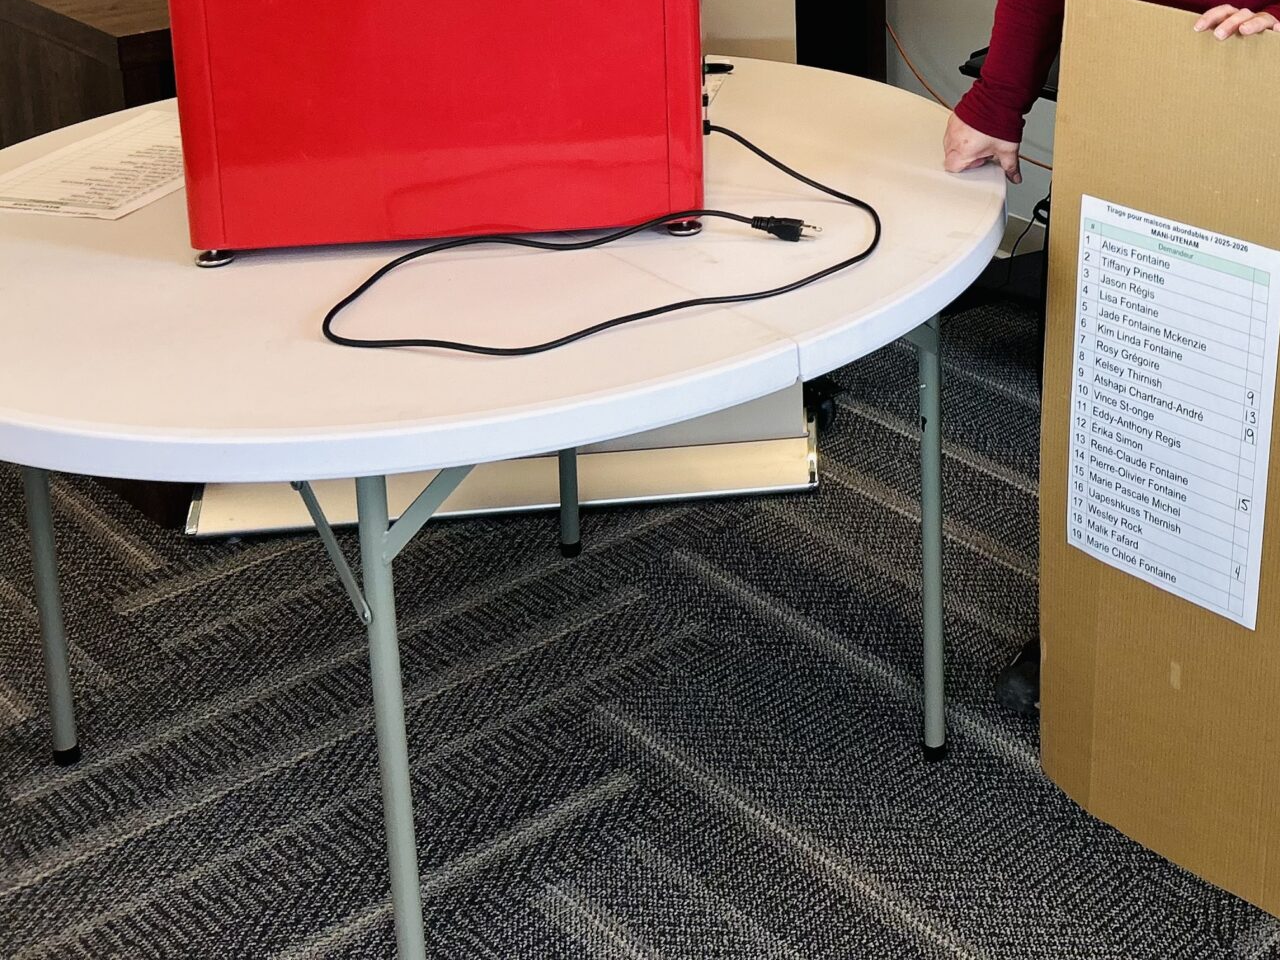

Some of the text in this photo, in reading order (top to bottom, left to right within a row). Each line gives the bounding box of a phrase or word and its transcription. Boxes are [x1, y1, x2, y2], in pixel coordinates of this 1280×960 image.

[1106, 205, 1126, 218] Tirage
[1127, 212, 1142, 222] pour
[1143, 217, 1171, 231] maisons
[1172, 226, 1209, 242] abordables
[1214, 237, 1249, 253] 2025-2026
[1150, 228, 1199, 249] MANI-UTENAM
[1085, 234, 1170, 269] 1 Alexis Fontaine
[1081, 300, 1207, 351] 5 Jade Fontaine Mckenzie
[1077, 350, 1085, 361] 8
[1094, 356, 1125, 377] Kelsey
[1079, 333, 1160, 370] 7 Rosy Grégoire
[1075, 432, 1188, 486] 13 René-Claude Fontaine
